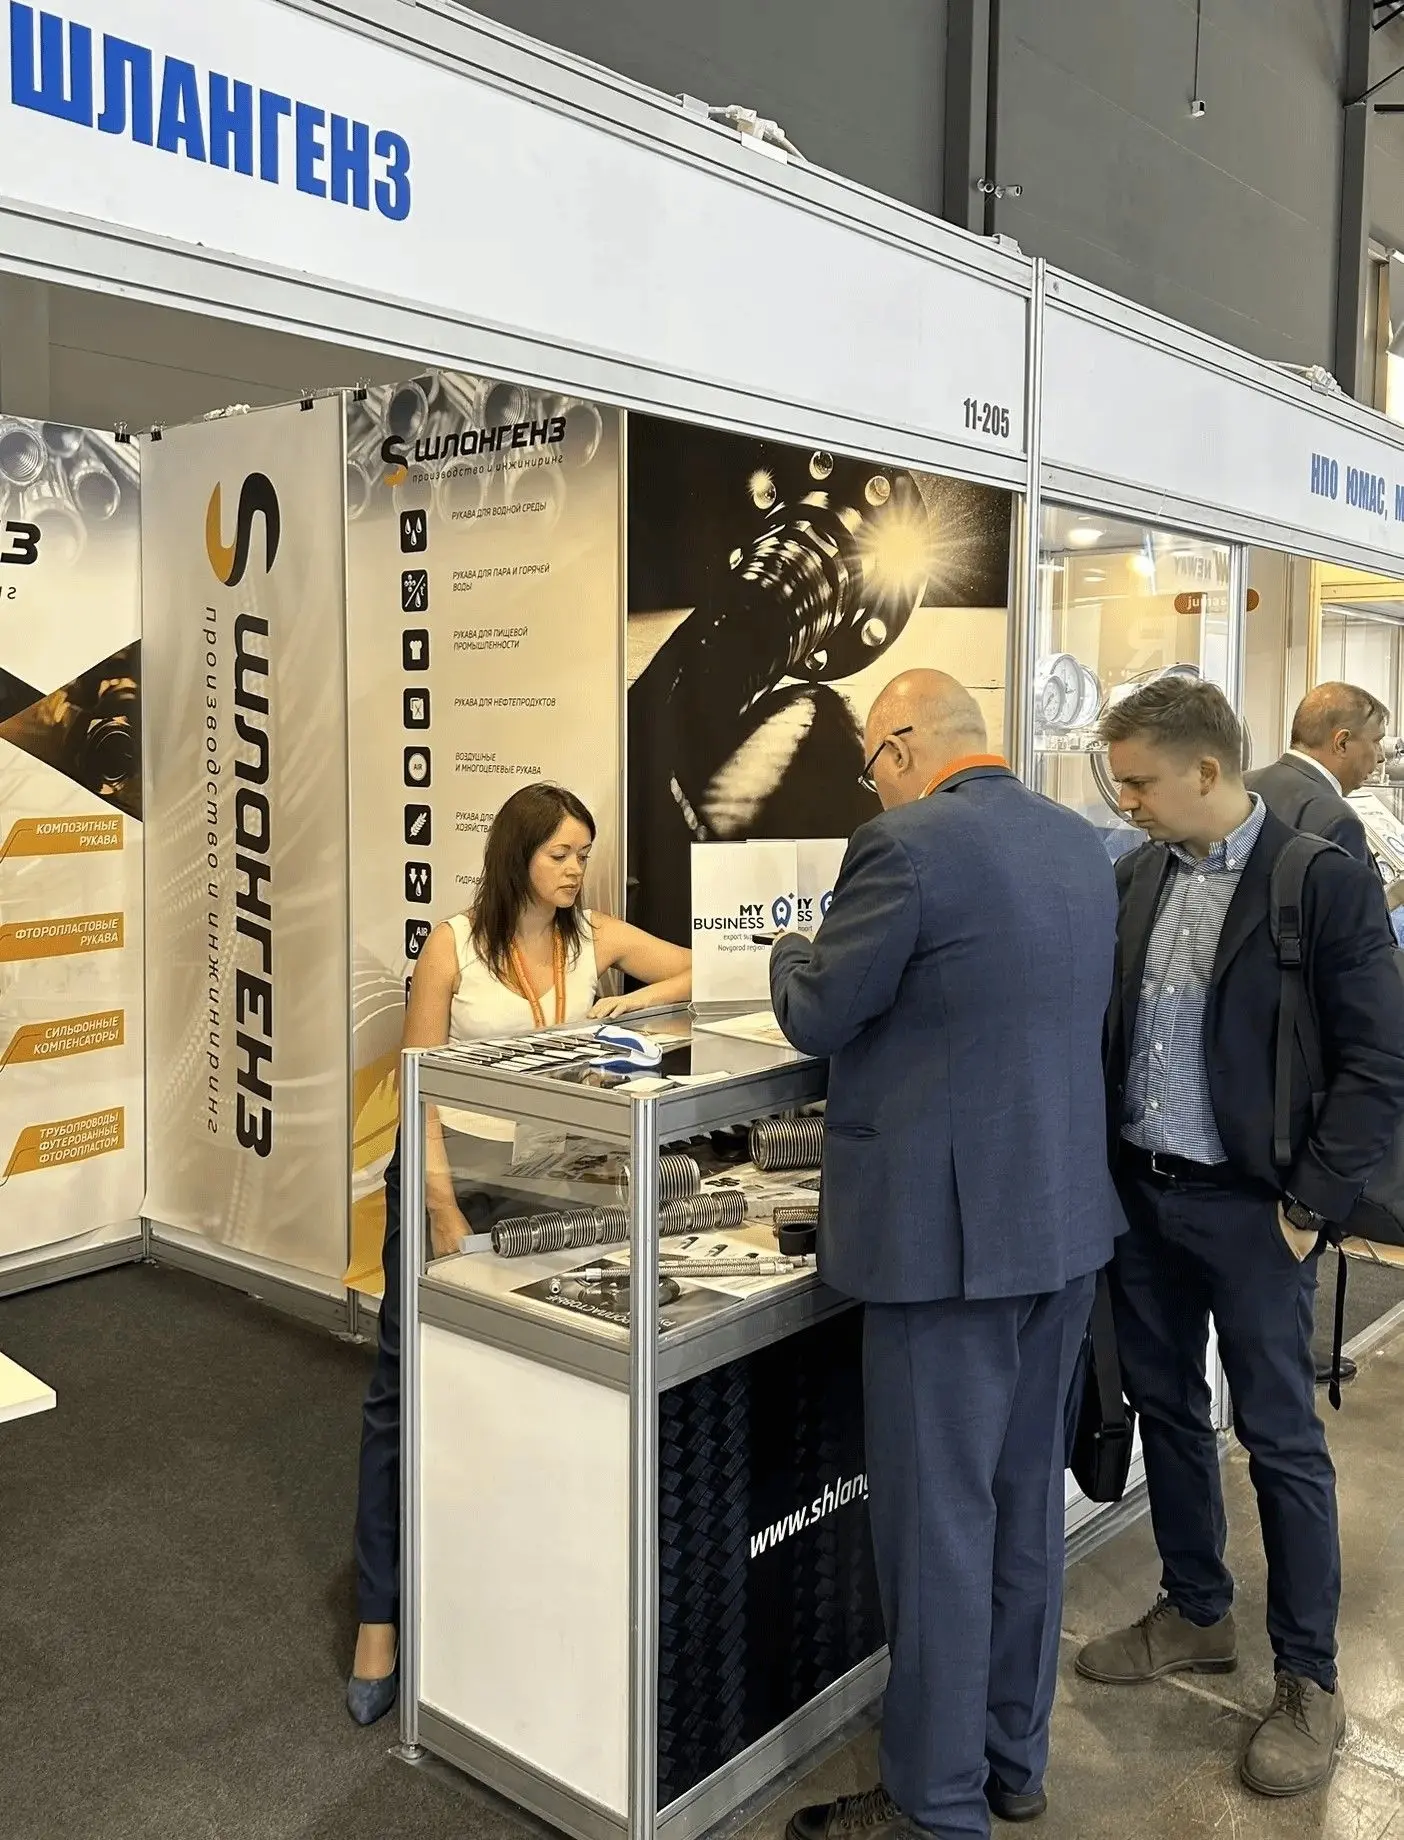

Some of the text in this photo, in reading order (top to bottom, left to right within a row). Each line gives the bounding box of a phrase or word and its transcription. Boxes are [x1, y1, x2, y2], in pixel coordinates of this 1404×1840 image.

[10, 0, 411, 221] ШЛАНГЕНЗ
[963, 397, 1010, 438] 11-205
[412, 465, 484, 484] производство
[495, 454, 564, 471] инжиниринг
[1310, 452, 1338, 500] НПО
[1346, 465, 1387, 521] ЮМАС,
[451, 502, 547, 520] РУКАВА ДЛЯ ВОДНОЙ СРЕДЫ
[452, 562, 550, 580] РУКАВА ДЛЯ ПАРА И ГОРЯЧЕЙ
[452, 582, 473, 592] ВОДЫ
[453, 626, 528, 639] РУКАВА ДЛЯ ПИЩЕВОЙ
[453, 640, 520, 652] ПРОМЫШЛЕННОСТИ
[454, 697, 557, 707] РУКАВА ДЛЯ НЕФТЕПРОДУКТОВ
[455, 752, 497, 762] ВОЗДУШНЫЕ
[455, 764, 542, 775] И МНОГОЦЕЛЕВЫЕ РУКАВА
[455, 811, 494, 822] РУКАВА ДЛЯ
[36, 819, 119, 835] КОМПОЗИТНЫЕ
[79, 834, 118, 847] РУКАВА
[205, 606, 221, 1134] производство и инжиниринг
[455, 874, 481, 886] ГИДРАВ
[739, 904, 764, 916] MY
[15, 918, 119, 940] ФТОРОПЛАСТОВЫЕ
[693, 917, 765, 930] BUSINESS
[80, 933, 119, 947] РУКАВА
[723, 933, 741, 942] export
[717, 944, 746, 953] Novgorod
[45, 1015, 120, 1039] СИЛЬФОННЫЕ
[33, 1030, 119, 1055] КОМПЕНСАТОРЫ
[39, 1112, 119, 1139] ТРУБОПРОВОДЫ
[39, 1123, 119, 1151] ФУТЕРОВАННЫЕ
[39, 1135, 119, 1163] ФТОРОПЛАСТОМ
